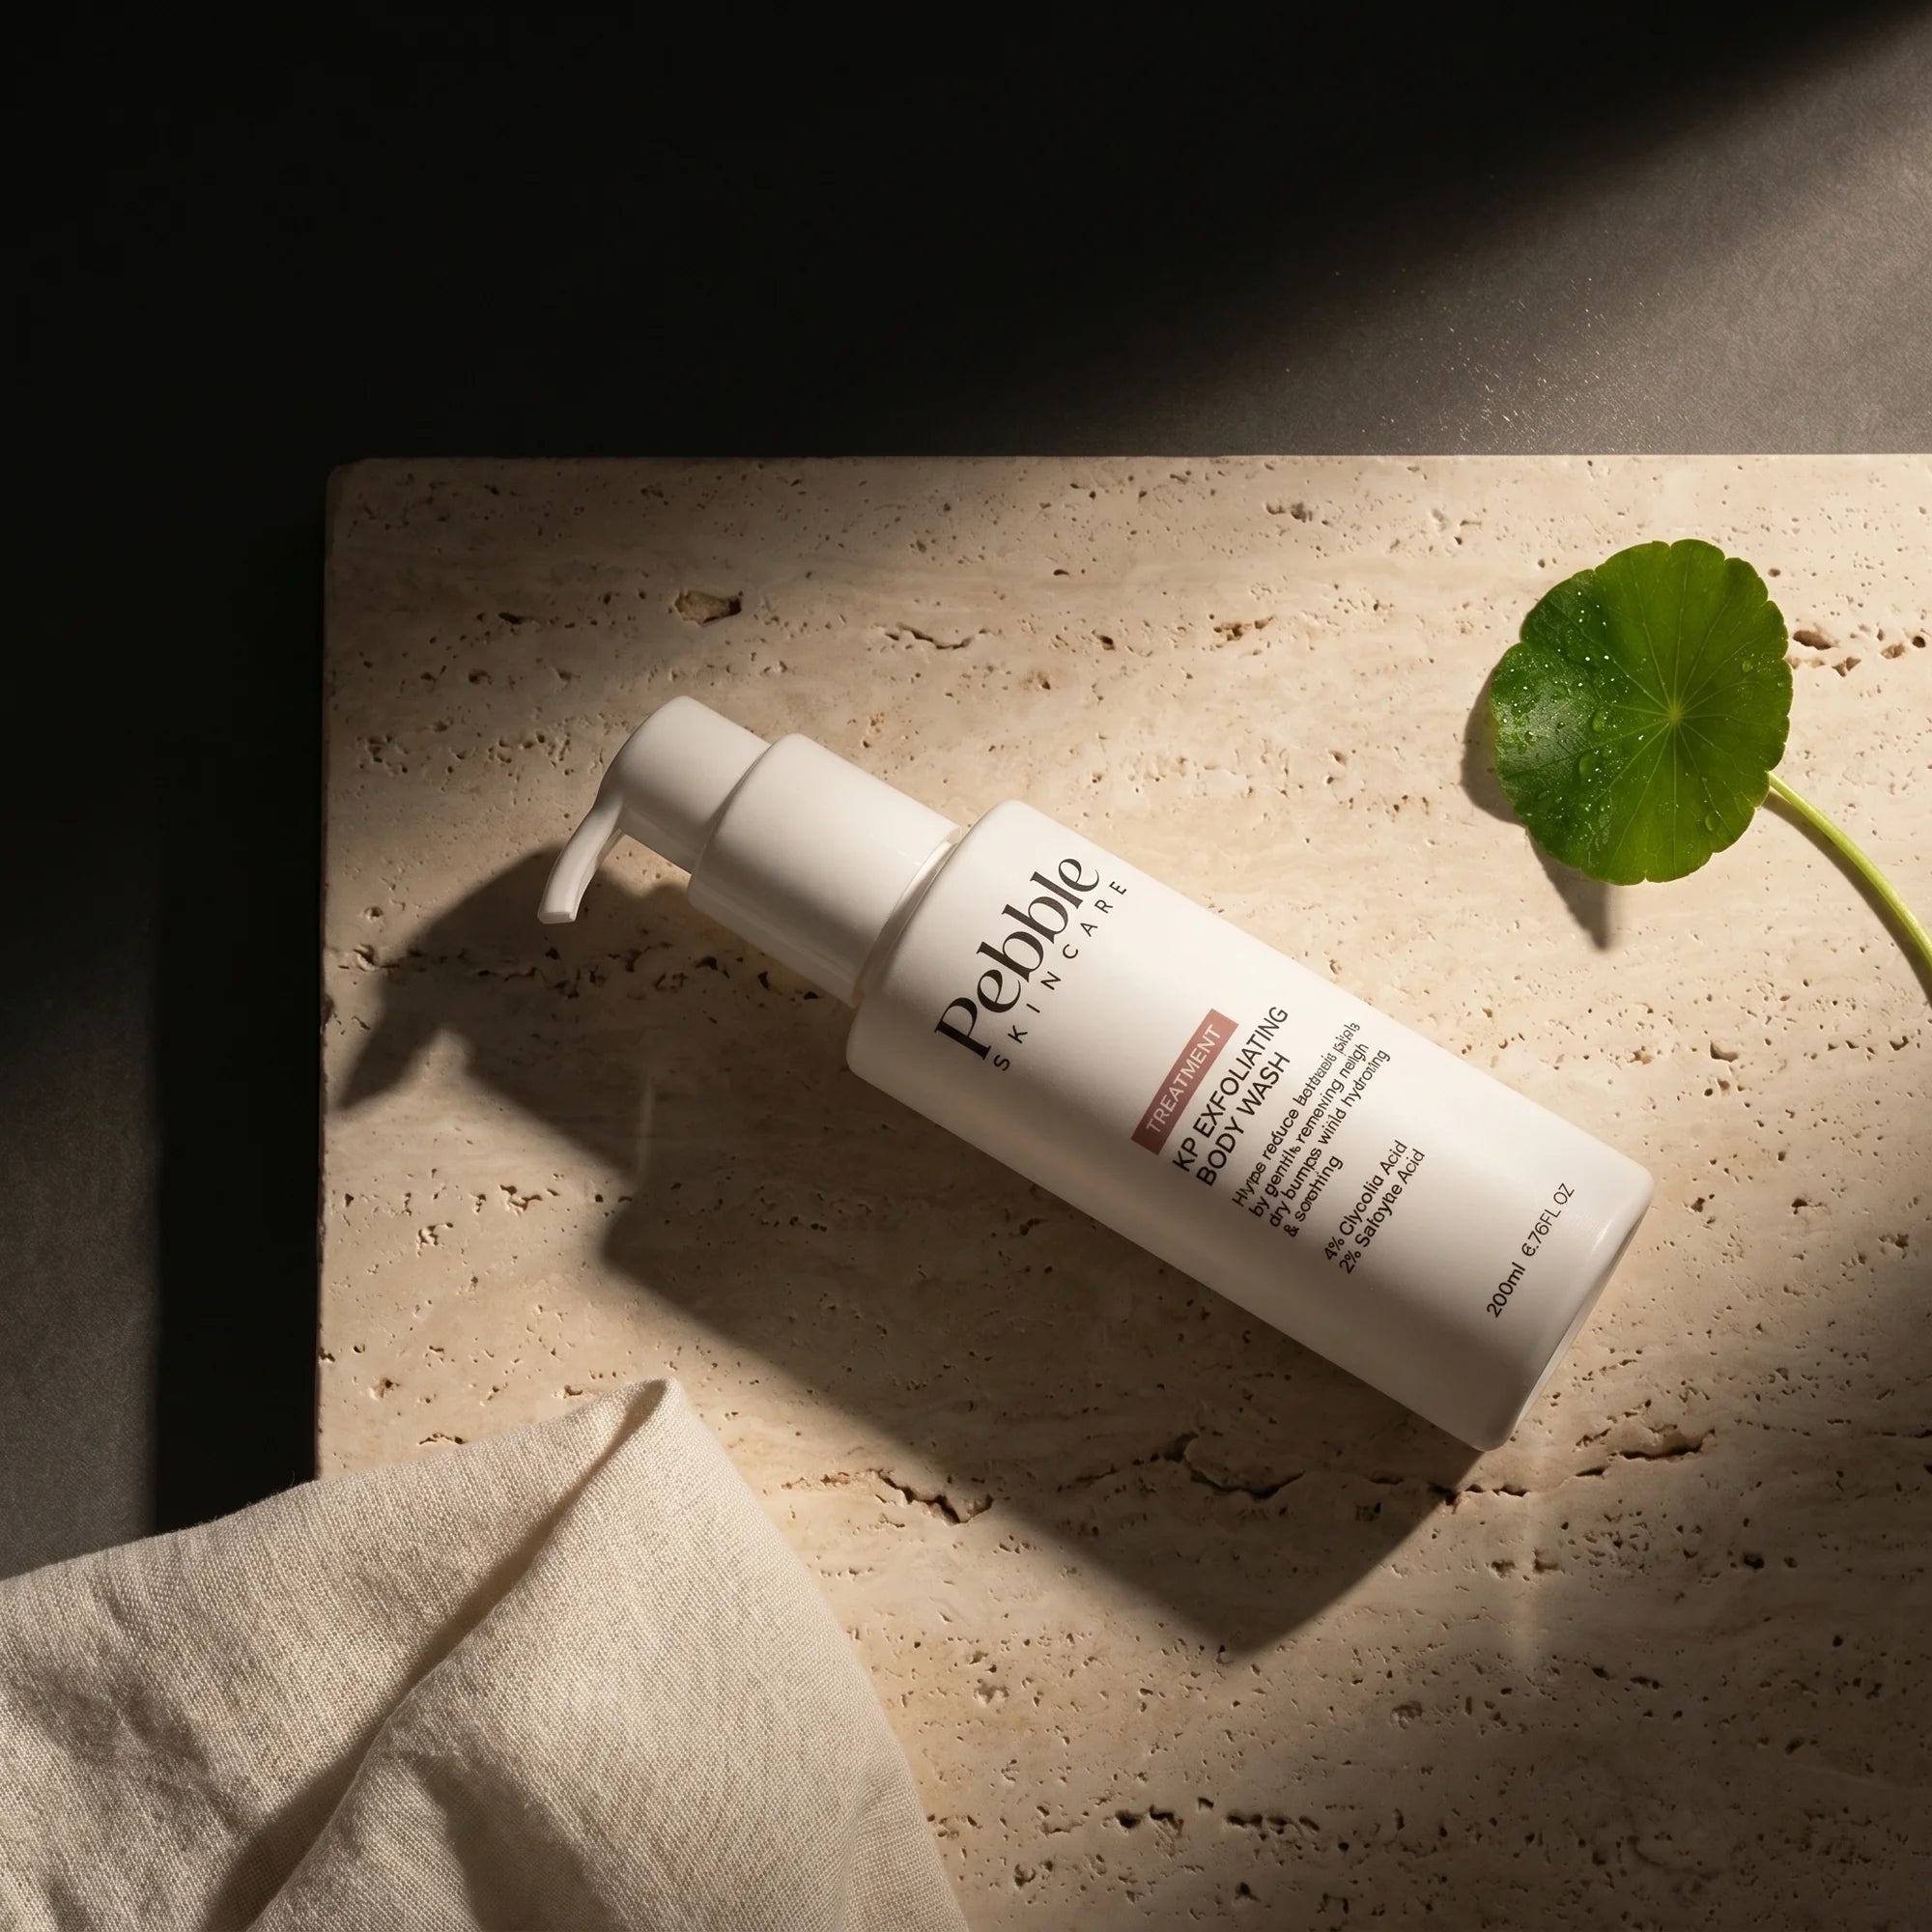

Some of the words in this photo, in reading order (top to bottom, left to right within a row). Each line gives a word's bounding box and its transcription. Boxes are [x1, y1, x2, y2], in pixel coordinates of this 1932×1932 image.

[933, 858, 1100, 1062] Pebble
[992, 880, 1127, 1072] SKINCARE
[1145, 1024, 1221, 1133] TREATMENT
[1171, 1136, 1199, 1173] KP
[1192, 1006, 1289, 1139] EXFOLIATING
[1194, 1115, 1245, 1187] BODY
[1236, 1051, 1291, 1117] WASH
[1262, 1108, 1300, 1161] reduce
[1247, 1195, 1271, 1218] by
[1268, 1200, 1292, 1228] dry
[1279, 1147, 1322, 1201] bumps
[1282, 1223, 1300, 1238] &
[1323, 1236, 1346, 1262] 4%
[1378, 1139, 1408, 1177] Acid
[1338, 1249, 1362, 1275] 2%
[1396, 1148, 1426, 1185] Acid
[1486, 1261, 1526, 1319] 200ml
[1552, 1182, 1576, 1206] OZ
